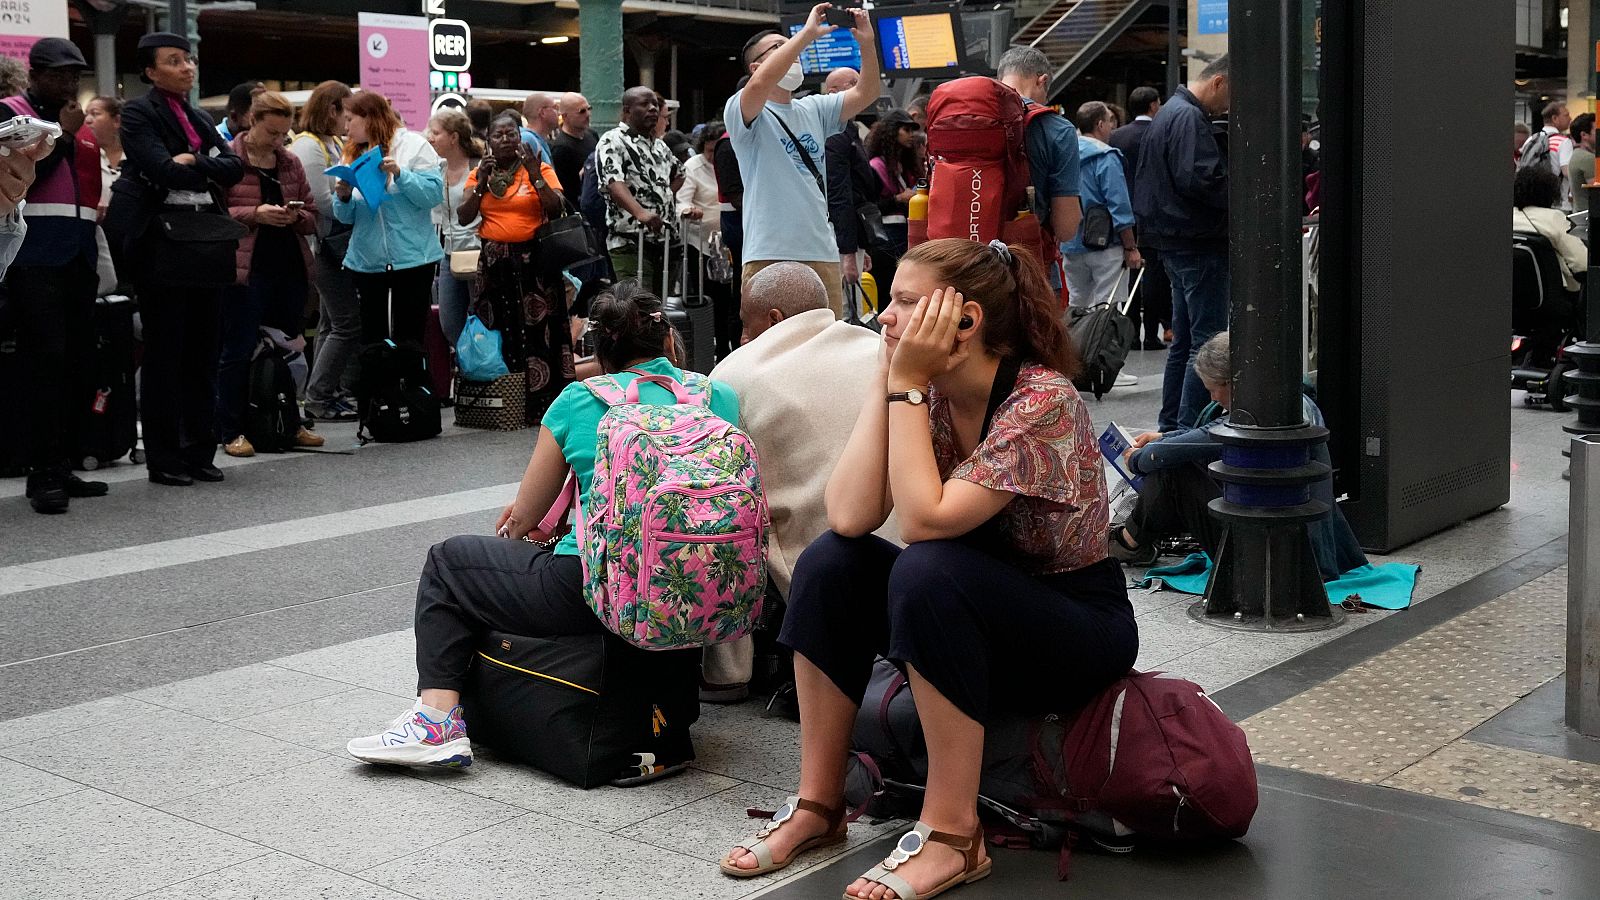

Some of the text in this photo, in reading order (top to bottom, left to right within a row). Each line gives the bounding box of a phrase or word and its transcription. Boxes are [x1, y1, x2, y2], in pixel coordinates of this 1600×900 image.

[0, 1, 30, 12] ARIS
[0, 13, 30, 24] 024
[434, 34, 466, 56] RER
[896, 19, 910, 69] circulation
[969, 169, 982, 242] ORTOVOX
